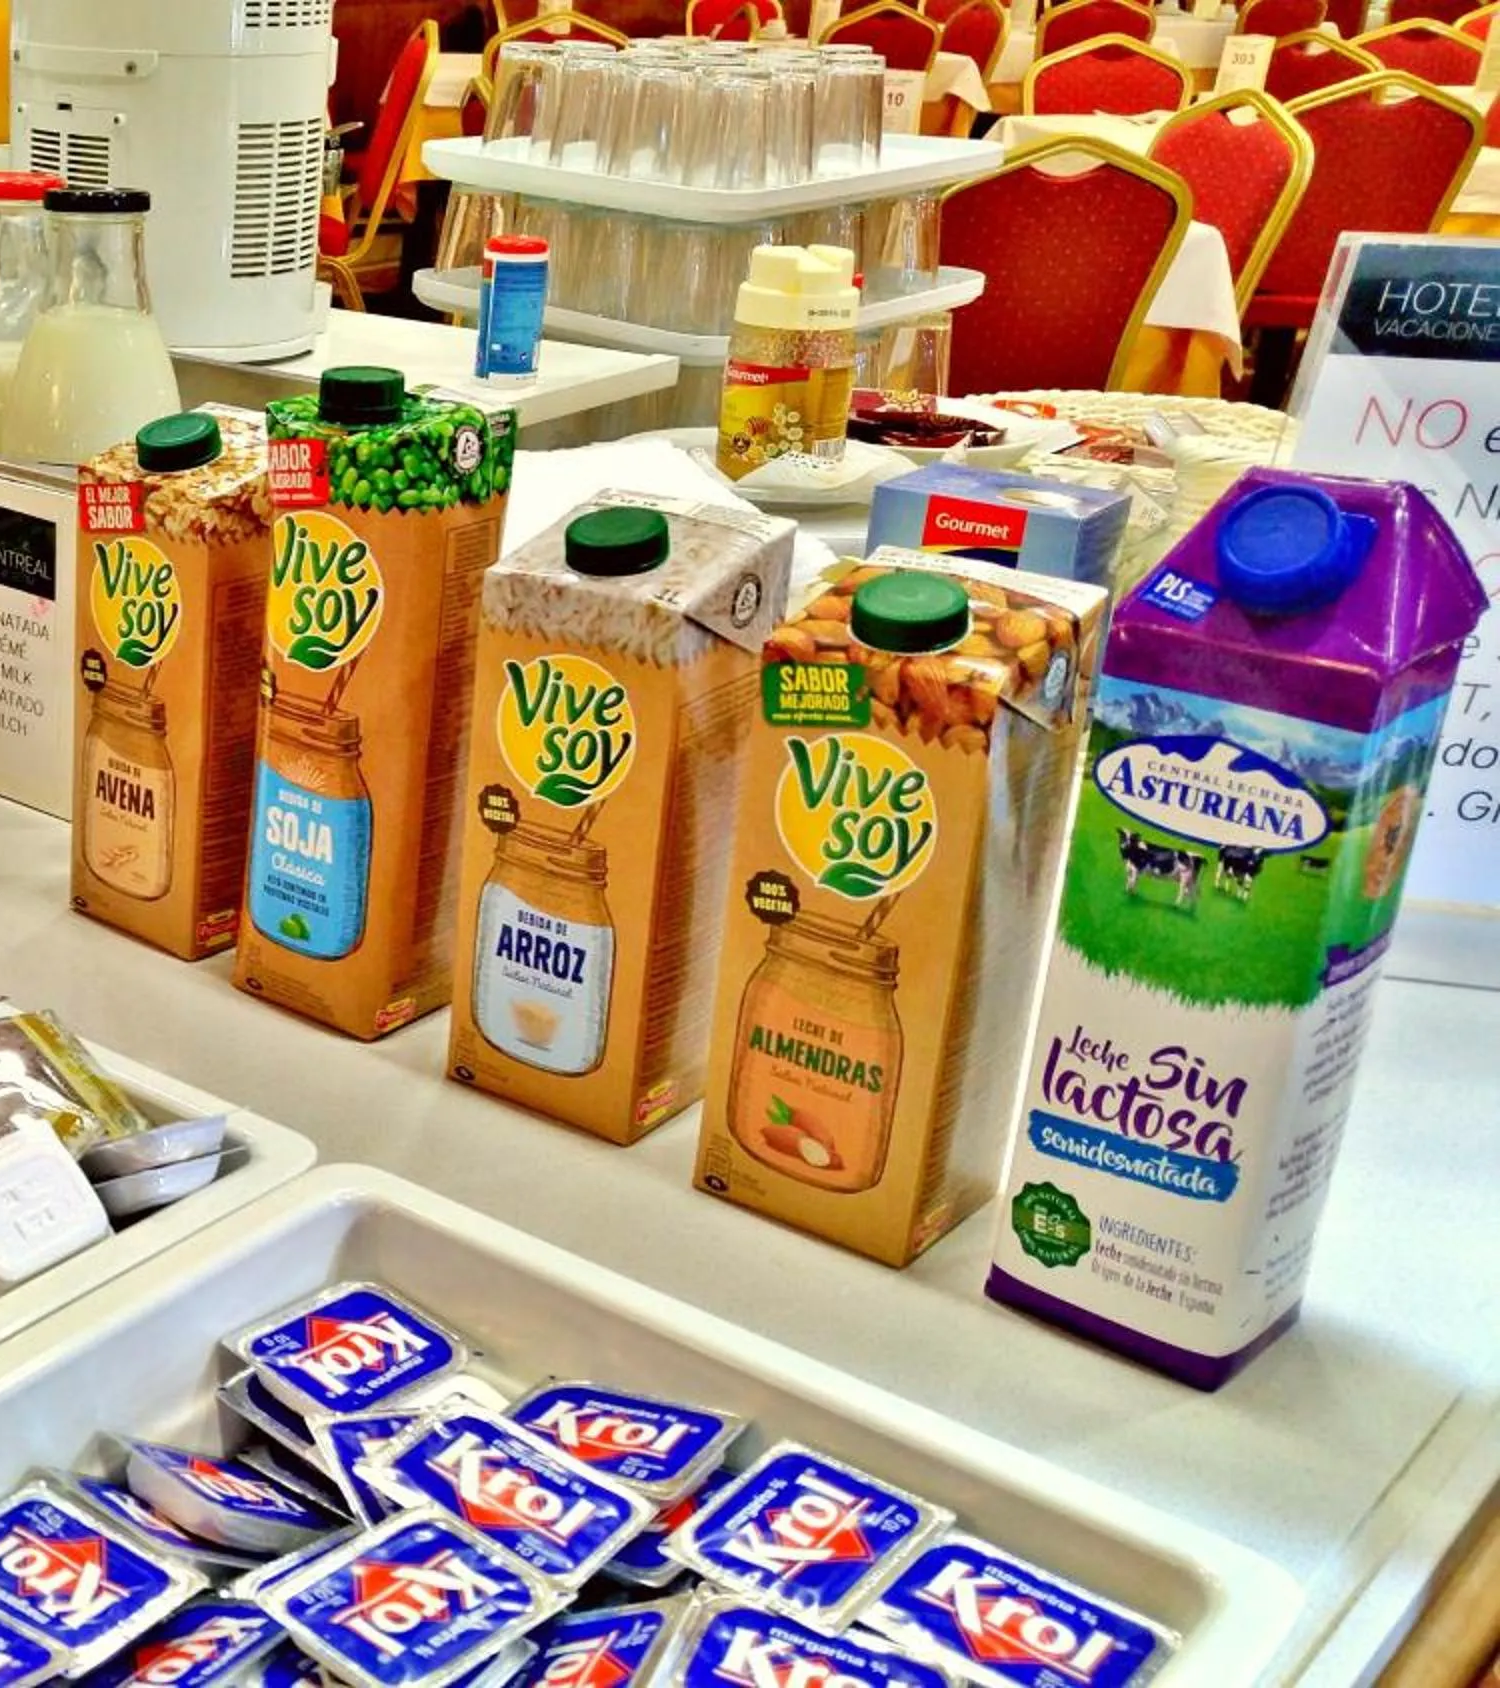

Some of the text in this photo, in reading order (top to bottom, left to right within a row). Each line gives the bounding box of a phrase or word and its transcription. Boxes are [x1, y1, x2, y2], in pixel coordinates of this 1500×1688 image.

[1356, 396, 1468, 449] NO
[268, 444, 312, 471] ABOR
[85, 487, 130, 502] EL MEJOR
[88, 504, 133, 529] SABOR
[935, 511, 1010, 540] Gourmet
[95, 540, 172, 599] Vive
[1154, 573, 1193, 601] PLS
[118, 598, 178, 653] soy
[289, 586, 379, 653] soy
[1, 660, 34, 686] MILK
[506, 658, 625, 727] Vive
[779, 665, 849, 693] SABOR
[779, 692, 849, 711] MEJORADO
[536, 726, 631, 786] soy
[787, 736, 926, 813] Vive
[96, 769, 155, 821] AVENA
[1146, 759, 1306, 810] CENTRAL LECHERA
[266, 806, 333, 864] SOJA
[822, 811, 933, 880] soy
[759, 881, 787, 897] 100%
[496, 923, 587, 985] ARROZ
[793, 1016, 826, 1040] LECHE
[749, 1023, 885, 1094] ALMENDRAS
[1065, 1025, 1248, 1118] Leche Sin
[1043, 1036, 1245, 1164] lactosa
[1041, 1126, 1218, 1196] semidesnatada
[294, 1316, 431, 1397] Krol
[533, 1401, 690, 1452] Krol
[433, 1432, 597, 1537] Krol
[722, 1472, 857, 1574] Krol
[346, 1557, 505, 1657] Krol
[925, 1559, 1115, 1672] Krol
[983, 1565, 1077, 1616] margarina
[769, 1627, 866, 1668] margarina
